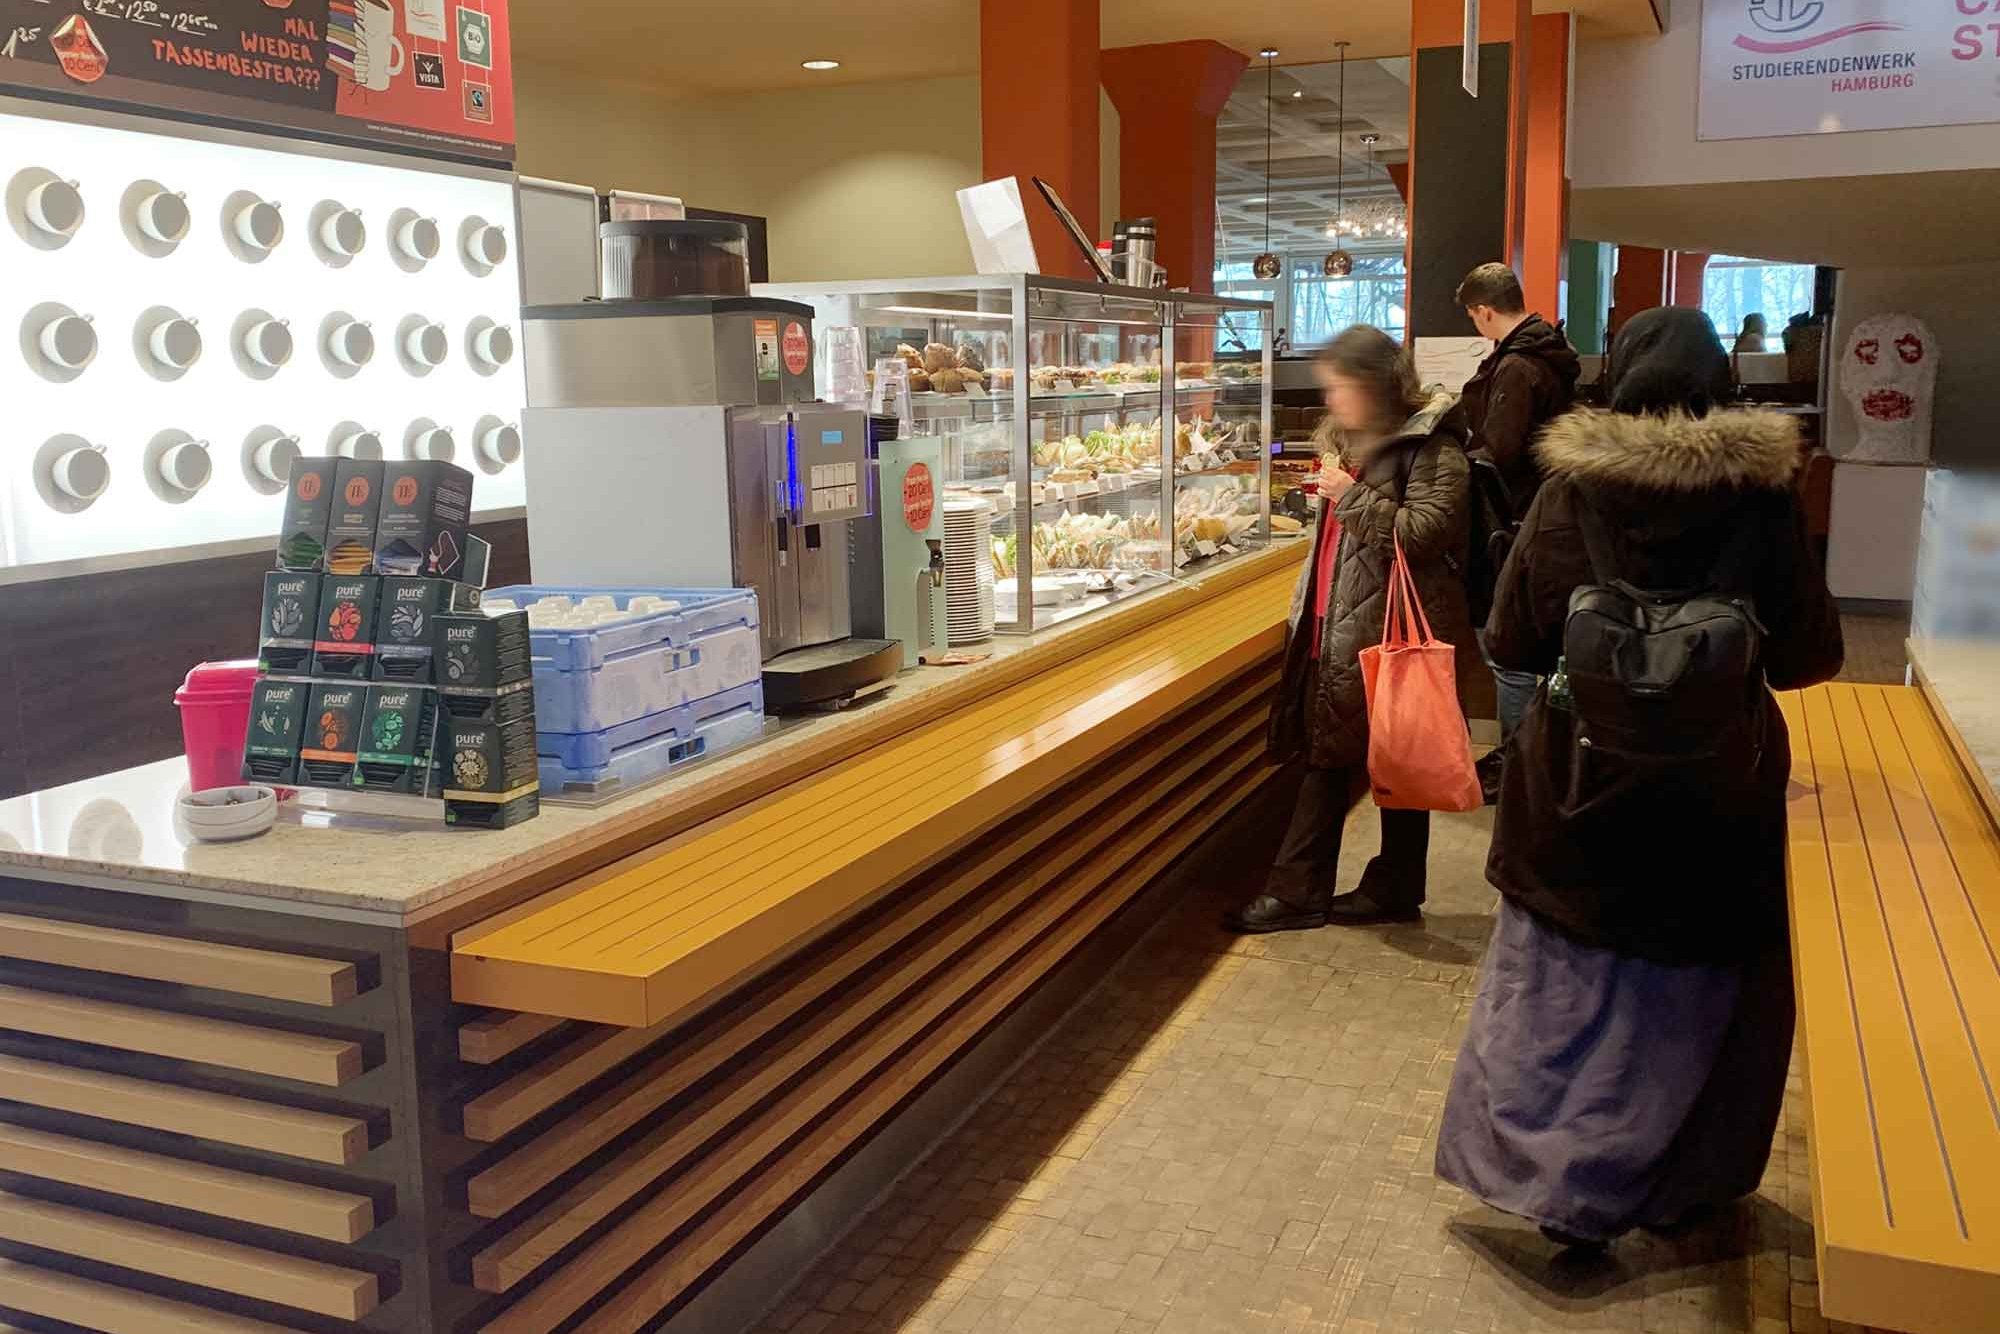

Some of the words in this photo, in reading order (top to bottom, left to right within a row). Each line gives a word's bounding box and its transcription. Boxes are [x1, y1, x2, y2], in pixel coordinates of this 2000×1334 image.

[284, 18, 319, 41] MAL
[241, 30, 313, 63] WIEDER
[152, 39, 321, 91] TASSENBESTER???
[1732, 52, 1916, 81] STUDIERENDENWERK
[419, 73, 440, 84] VISTA
[1831, 73, 1914, 93] HAMBURG
[278, 582, 304, 596] pure
[336, 585, 363, 599] pure
[397, 587, 425, 600] pure
[447, 626, 475, 640] pure
[265, 689, 292, 702] pure
[324, 694, 351, 707] pure
[379, 694, 407, 708] pure
[455, 733, 484, 747] pure
